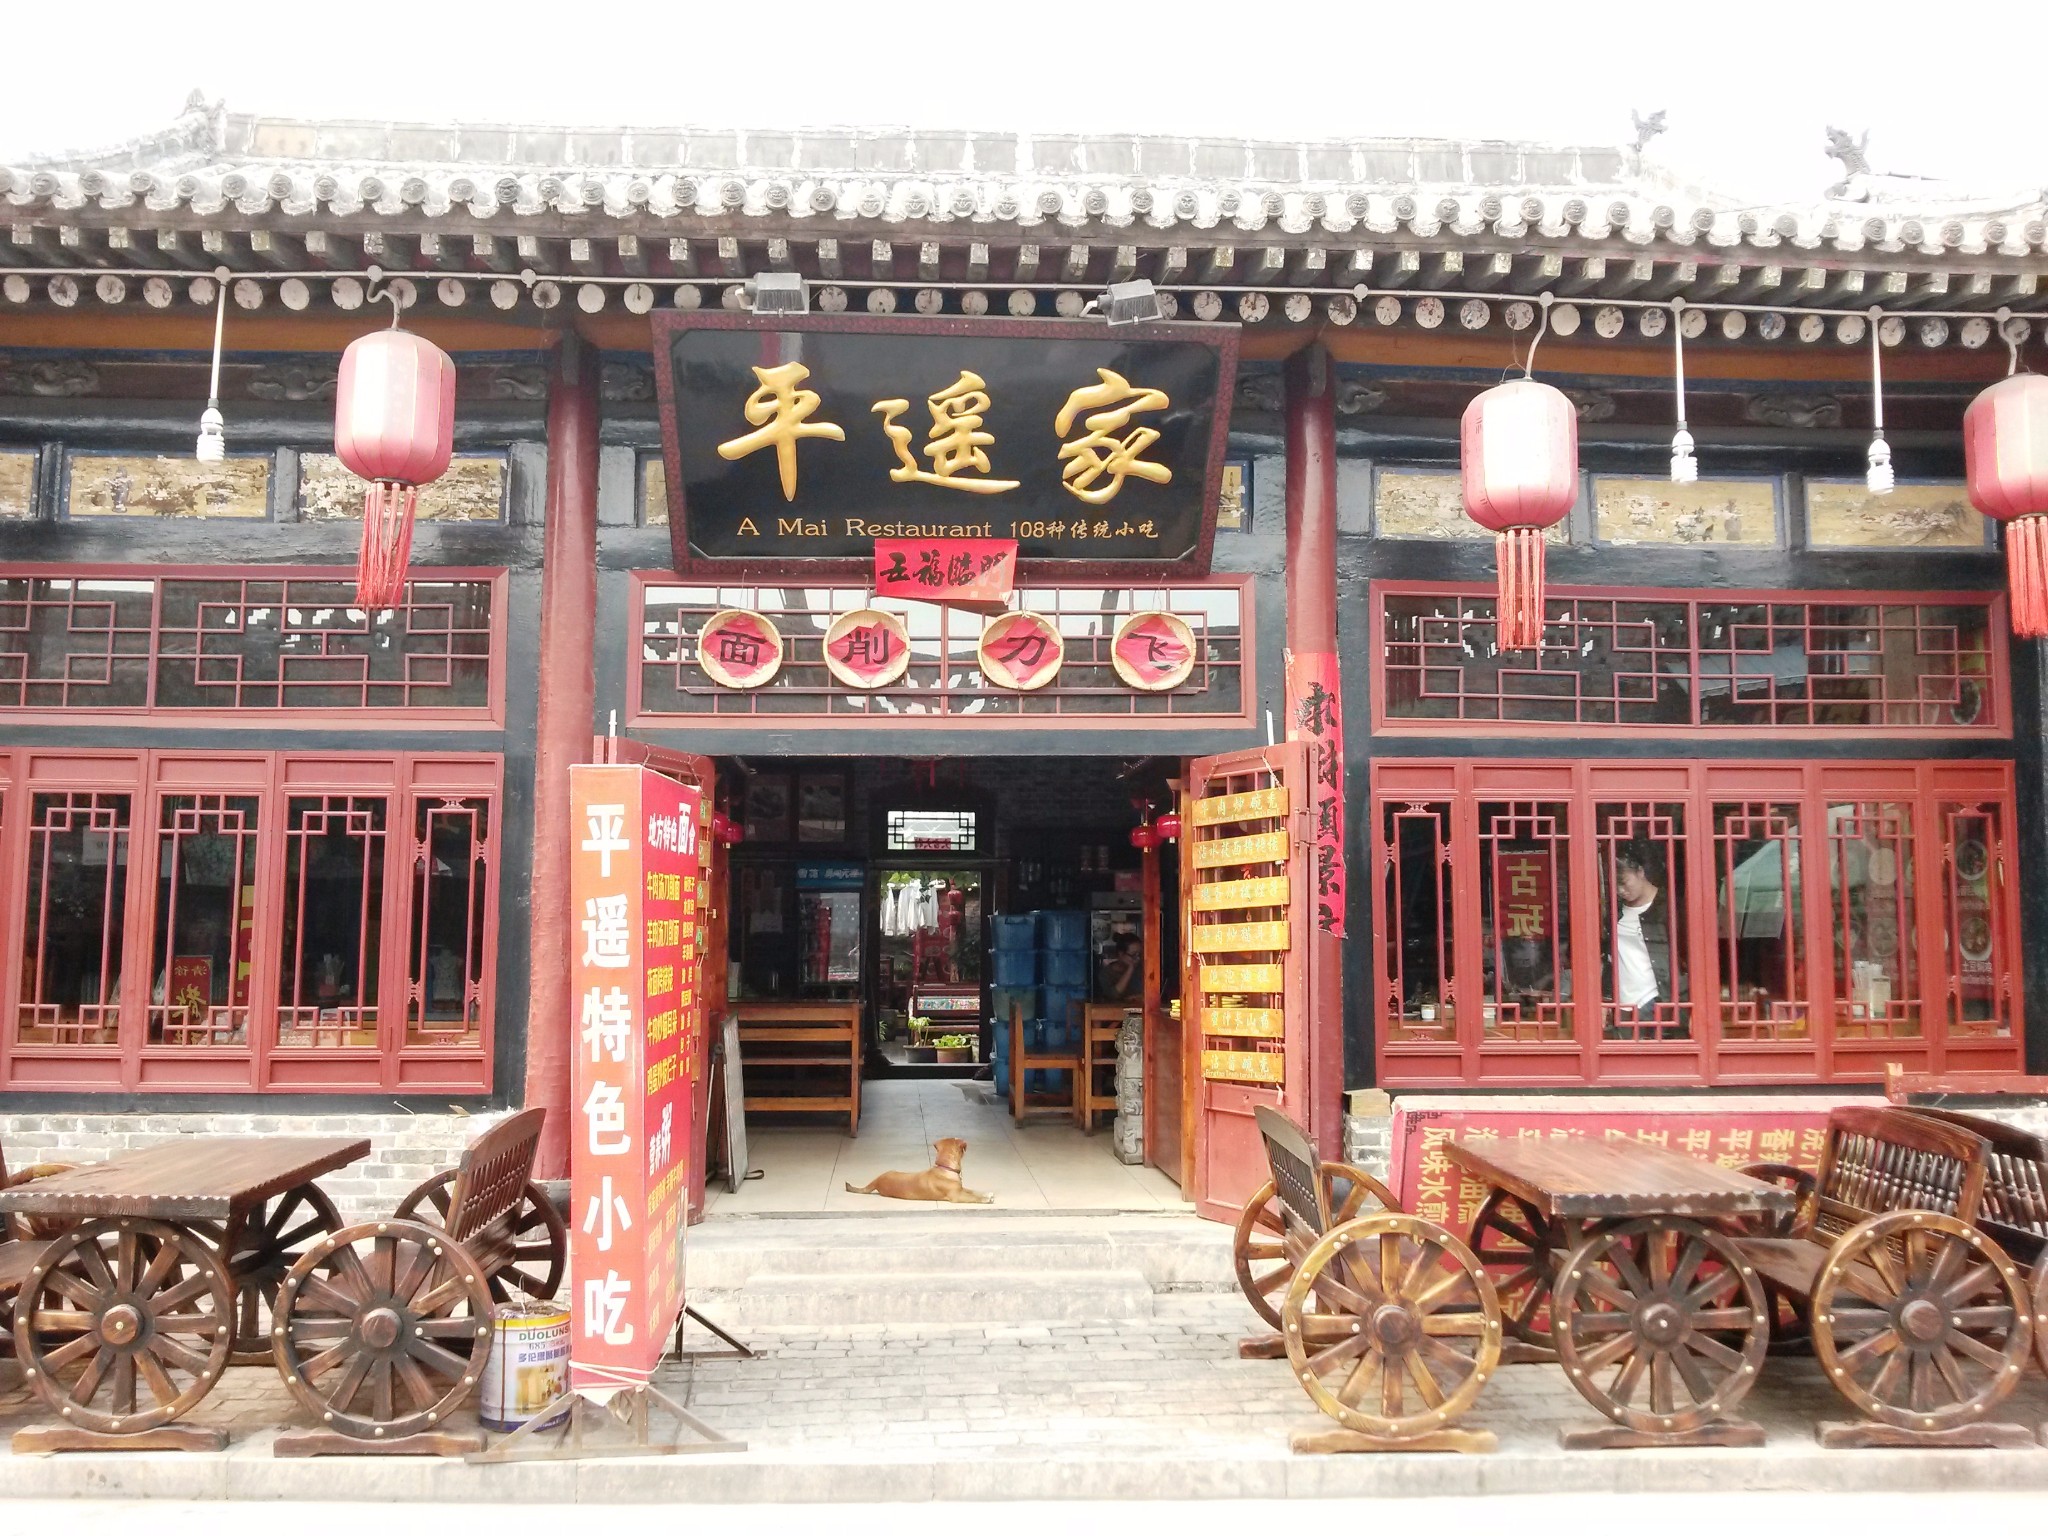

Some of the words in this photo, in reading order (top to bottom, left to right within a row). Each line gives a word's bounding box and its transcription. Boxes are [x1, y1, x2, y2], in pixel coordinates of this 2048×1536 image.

[717, 360, 1173, 504] 平遥家
[737, 518, 760, 536] A
[778, 518, 827, 536] Mai
[846, 519, 992, 538] Restaurant
[717, 629, 767, 666] 面
[841, 629, 890, 666] 削
[998, 634, 1050, 667] 刀
[1126, 631, 1178, 671] 飞
[648, 802, 695, 856] 地方特色面食
[581, 803, 633, 1346] 平遥特色小吃
